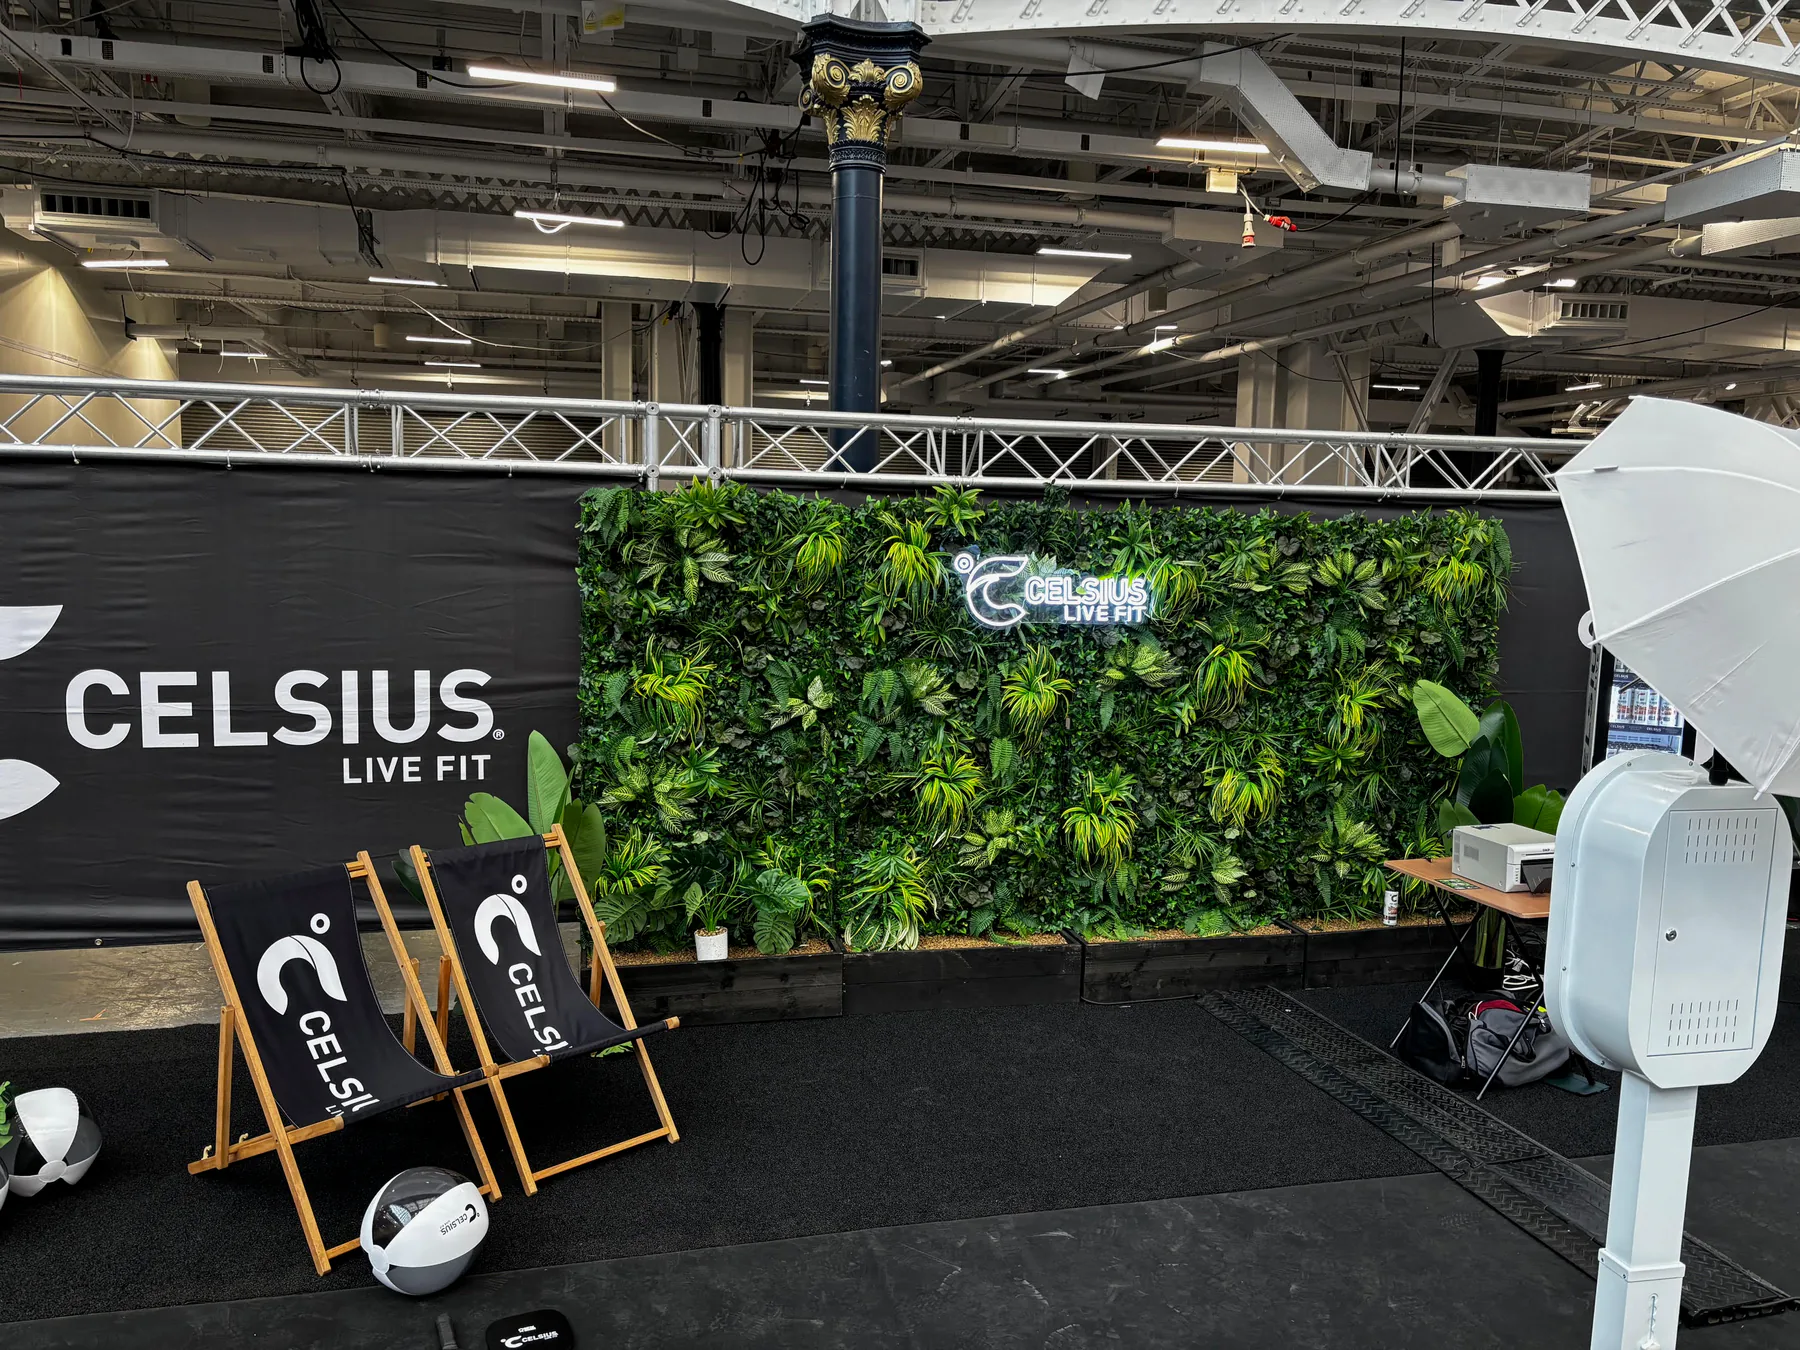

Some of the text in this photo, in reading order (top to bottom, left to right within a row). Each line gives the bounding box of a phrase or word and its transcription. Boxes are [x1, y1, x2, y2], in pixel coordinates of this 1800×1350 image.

[1025, 576, 1147, 605] CELSIUS
[1064, 604, 1147, 623] LIVE FIT
[342, 754, 491, 784] LIVE FIT
[508, 962, 573, 1052] CELSI
[440, 1213, 468, 1236] CELSIUS
[521, 1330, 559, 1343] CELSIUS
